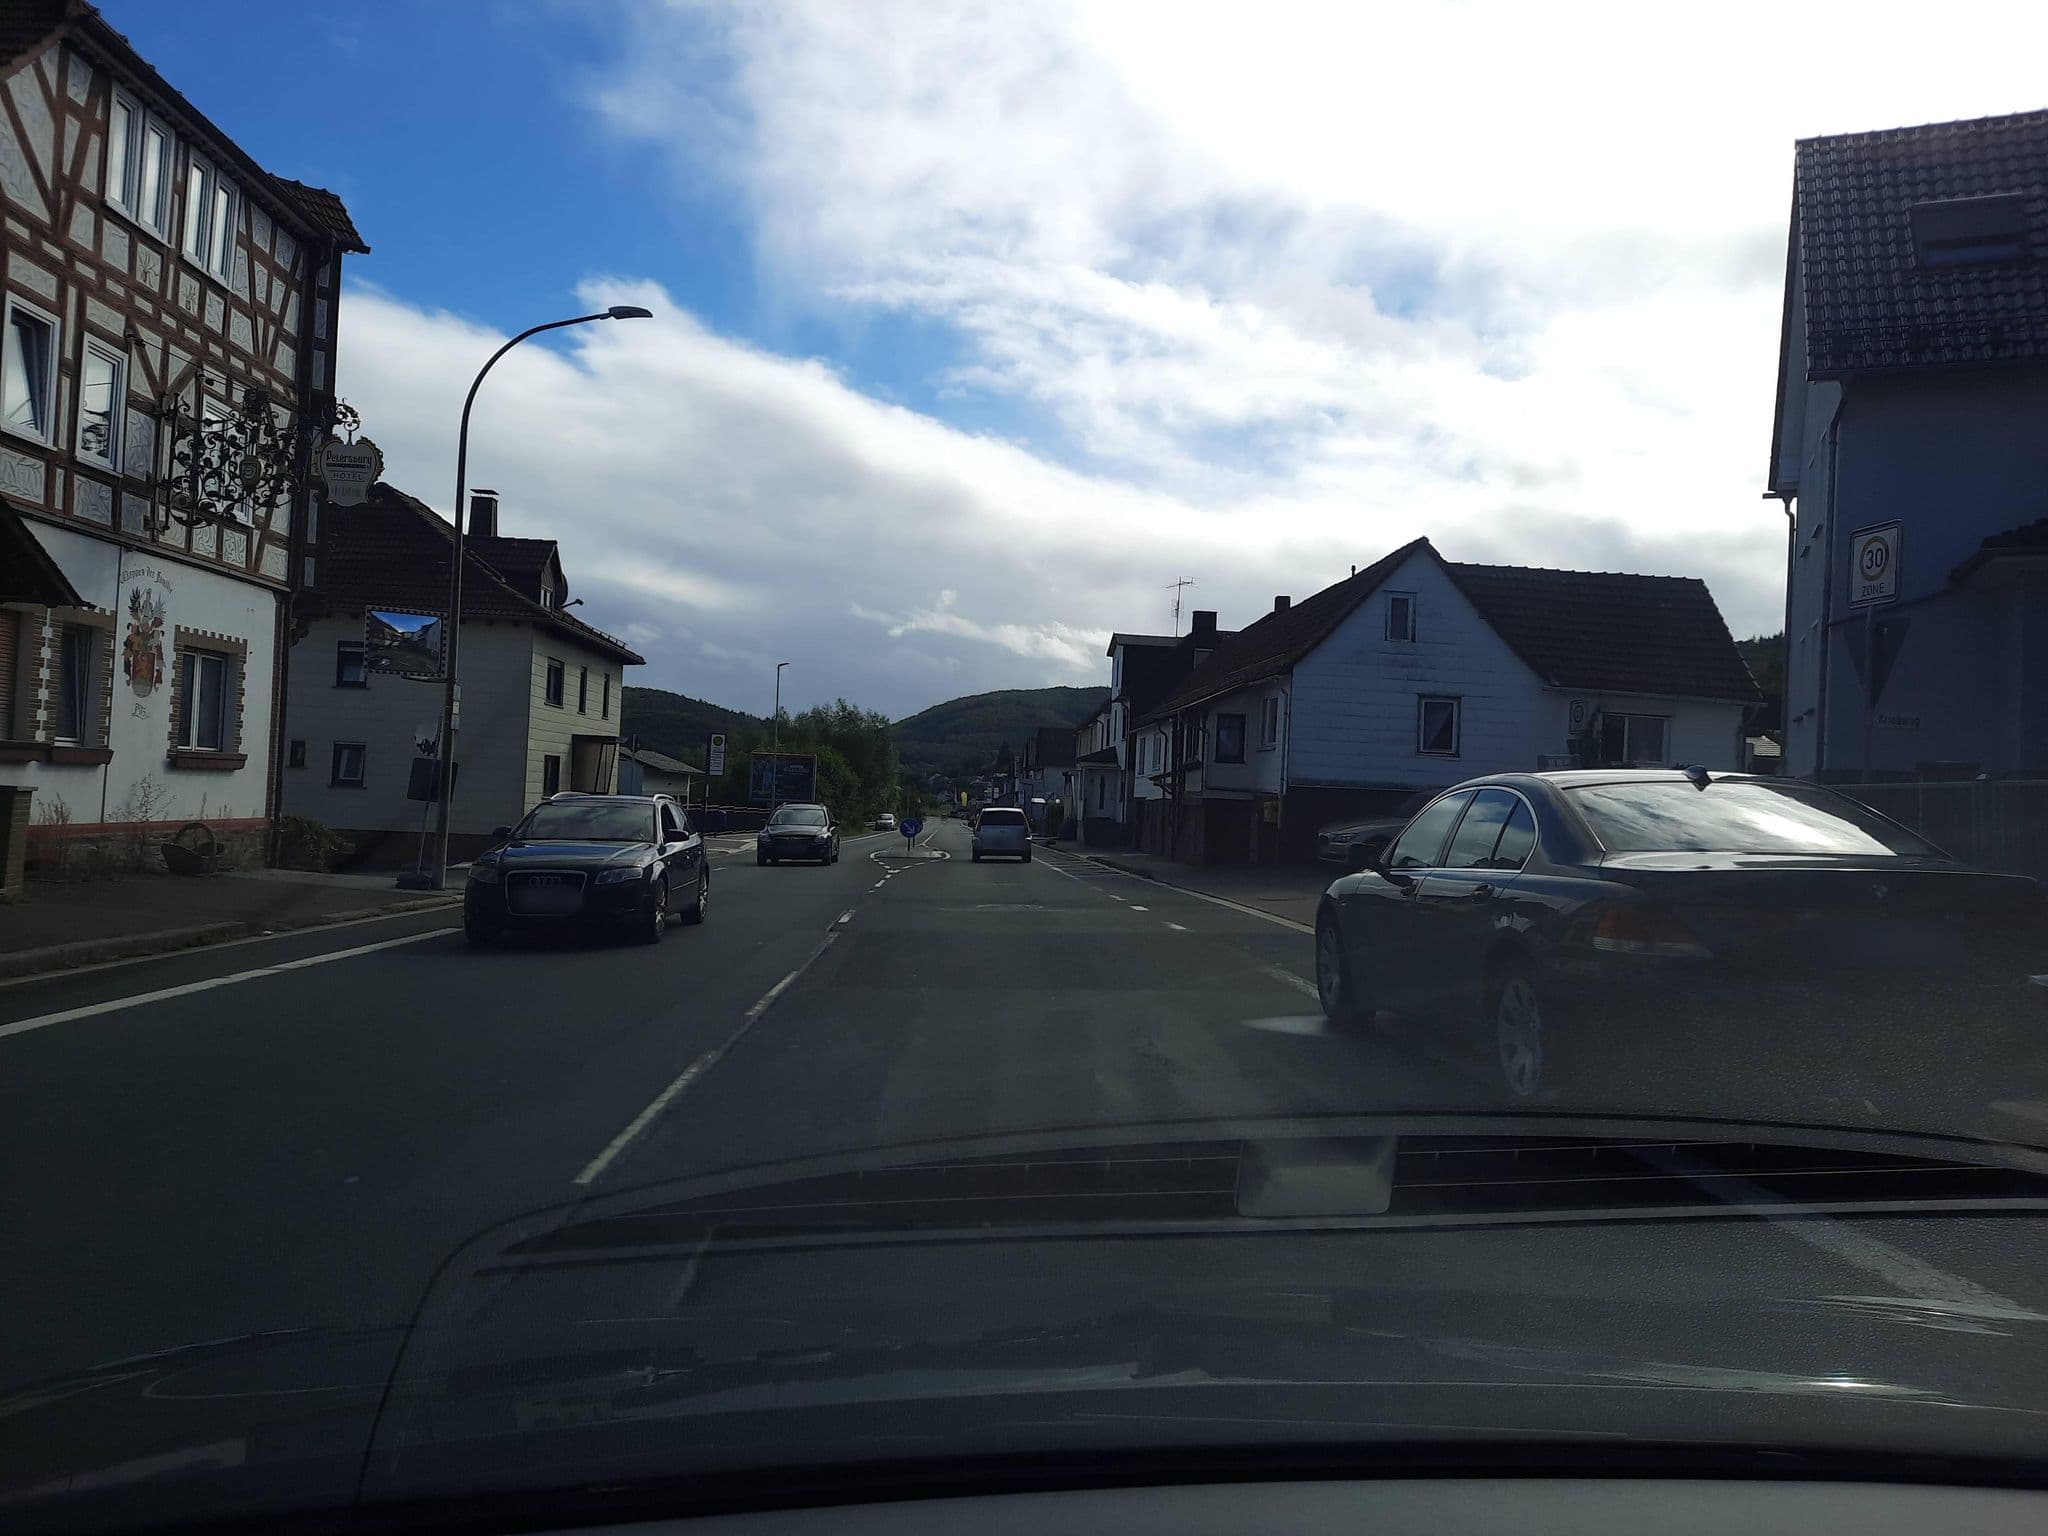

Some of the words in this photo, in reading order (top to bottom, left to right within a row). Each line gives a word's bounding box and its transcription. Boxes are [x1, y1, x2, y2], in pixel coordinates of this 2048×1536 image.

[326, 450, 373, 468] Petersburg
[332, 472, 363, 481] HOTEL
[1865, 548, 1884, 570] 30
[1861, 582, 1885, 598] ZONE
